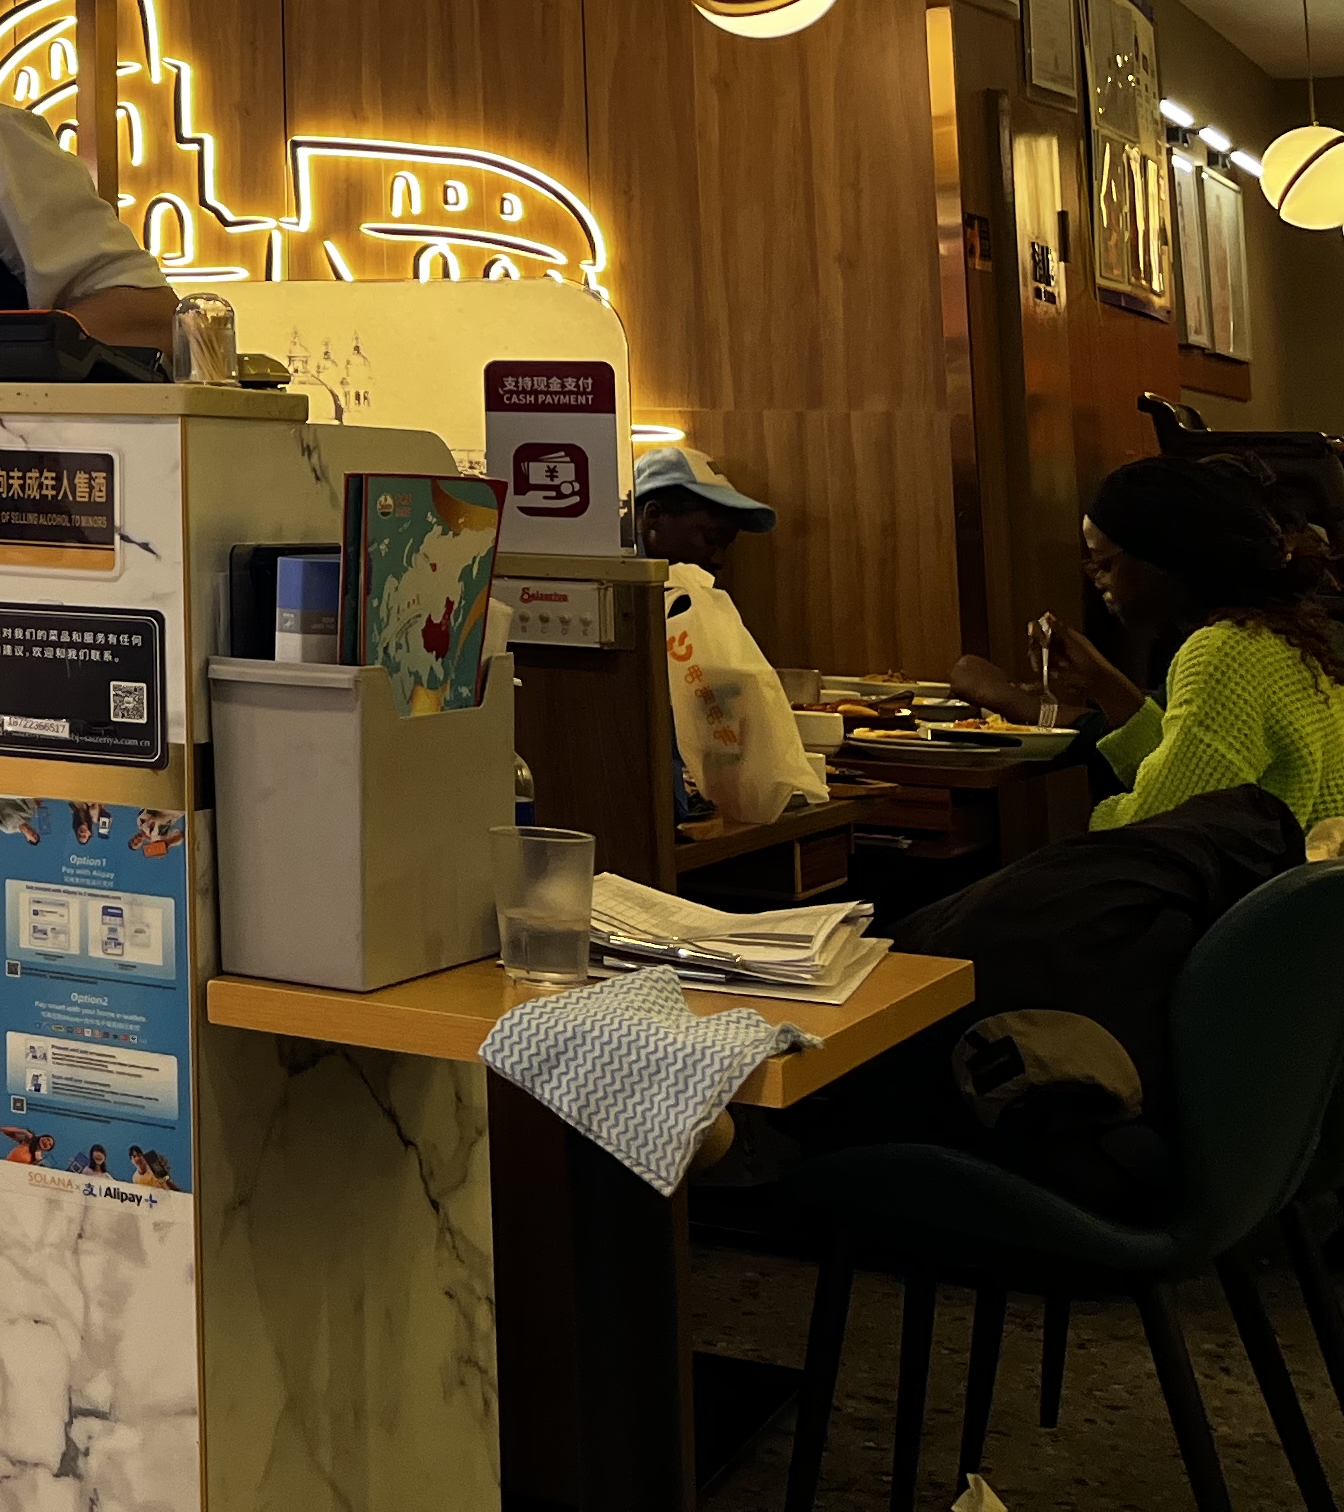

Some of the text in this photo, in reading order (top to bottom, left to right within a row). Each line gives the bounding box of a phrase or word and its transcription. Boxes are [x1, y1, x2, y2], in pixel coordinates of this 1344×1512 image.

[503, 376, 593, 392] 支持现金支付
[503, 393, 594, 406] CASH PAYMENT
[1, 512, 10, 523] OF
[11, 512, 38, 525] SELLING
[39, 514, 70, 527] ALCOHOL
[71, 515, 81, 527] TO
[28, 1171, 73, 1190] SOLANA
